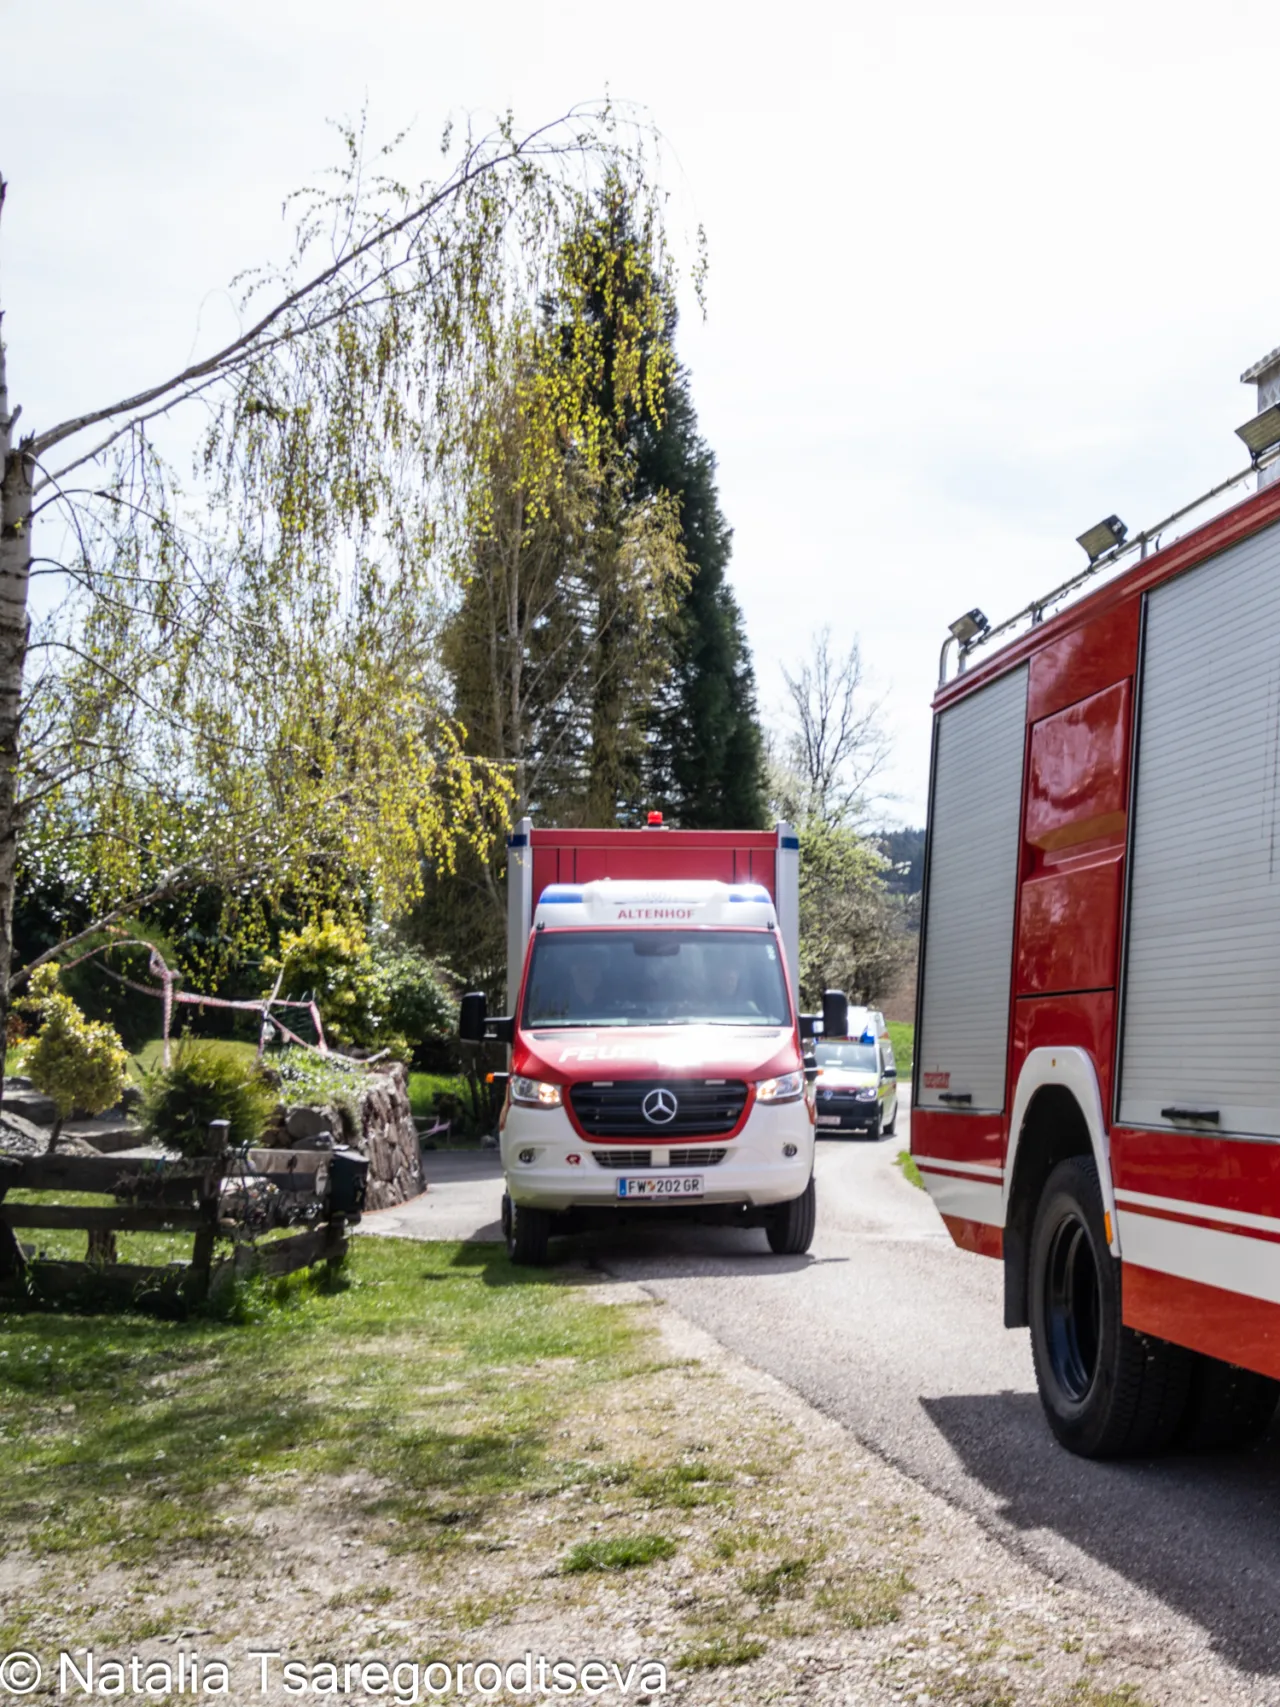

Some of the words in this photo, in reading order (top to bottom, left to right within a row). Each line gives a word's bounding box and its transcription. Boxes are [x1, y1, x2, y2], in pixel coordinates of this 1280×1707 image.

[617, 908, 696, 920] ALTENHOF
[628, 1179, 647, 1194] FW
[656, 1179, 681, 1194] 202
[683, 1178, 700, 1192] GR
